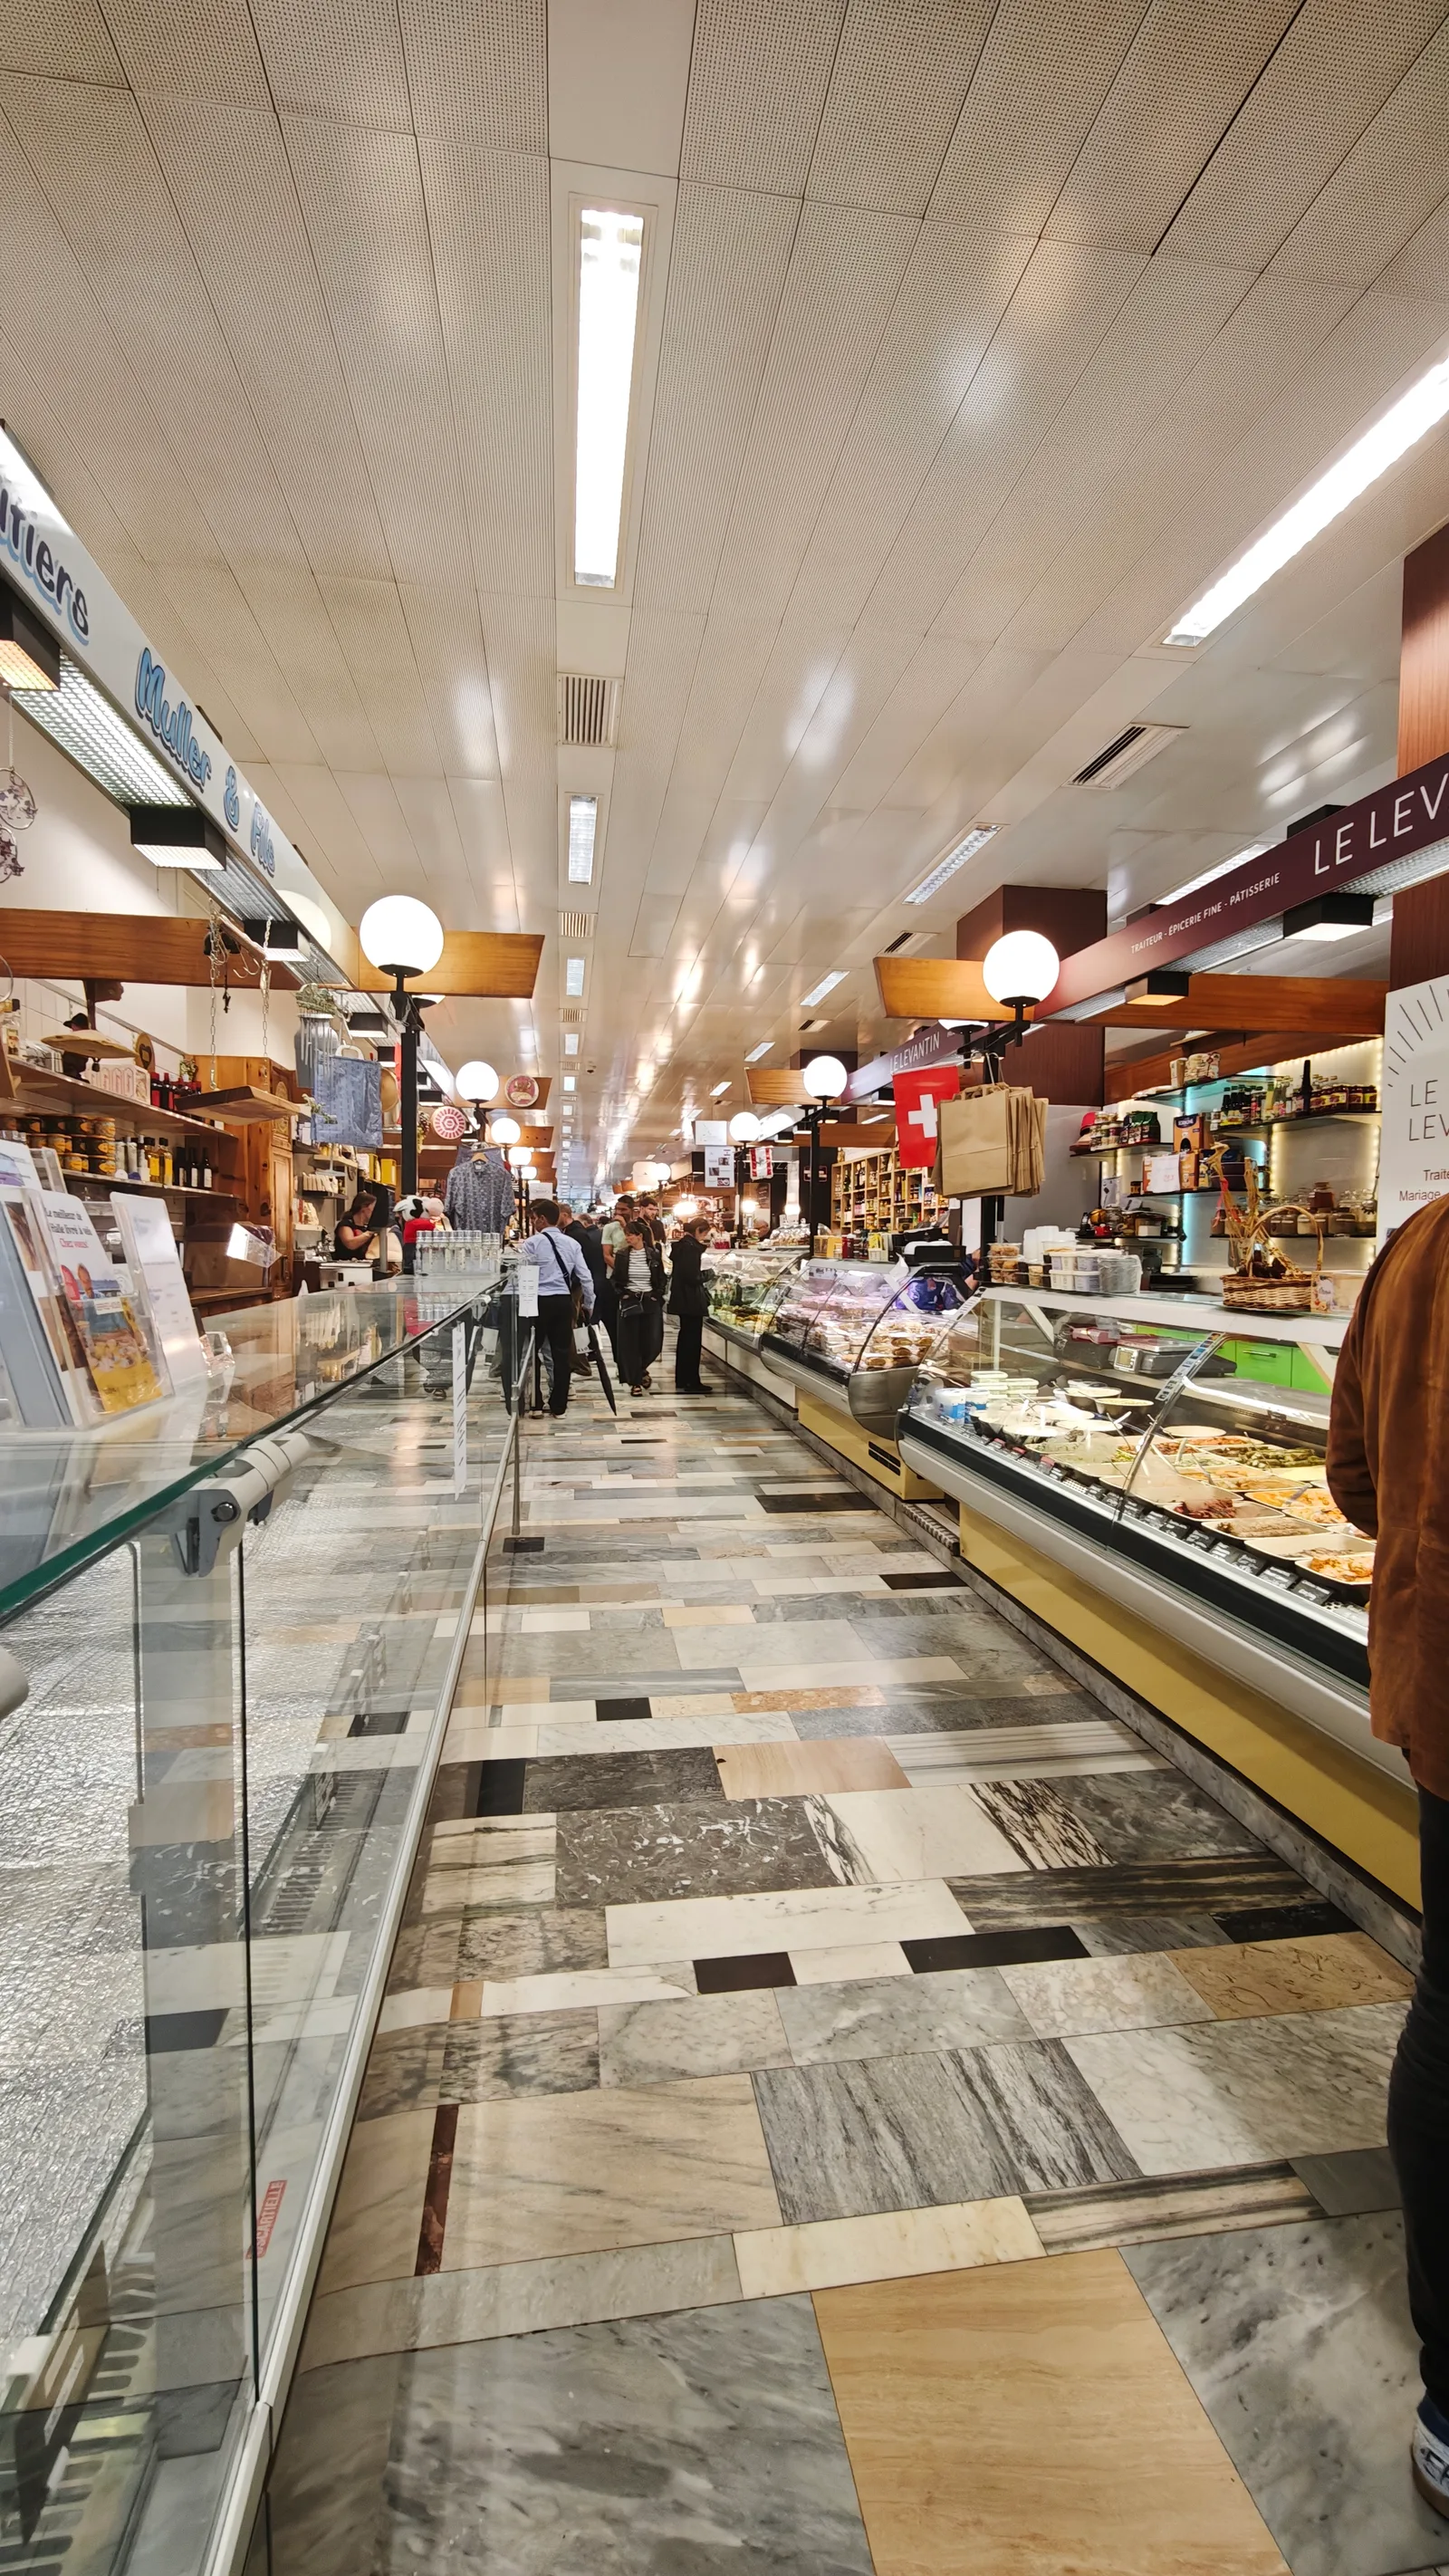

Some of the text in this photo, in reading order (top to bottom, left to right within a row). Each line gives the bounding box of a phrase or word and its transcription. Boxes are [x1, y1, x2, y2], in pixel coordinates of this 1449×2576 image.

[135, 647, 275, 877] Muller & Fils
[1314, 822, 1355, 876] LE
[1131, 931, 1163, 954] TRAITEUR
[1168, 912, 1202, 937] ÉPICERIE
[1203, 901, 1223, 919] FINE
[1229, 872, 1281, 907] PÂTISSERIE
[890, 1031, 940, 1072] LE LEVANTIN
[1410, 1079, 1438, 1107] LE
[1399, 1189, 1441, 1203] Mariage
